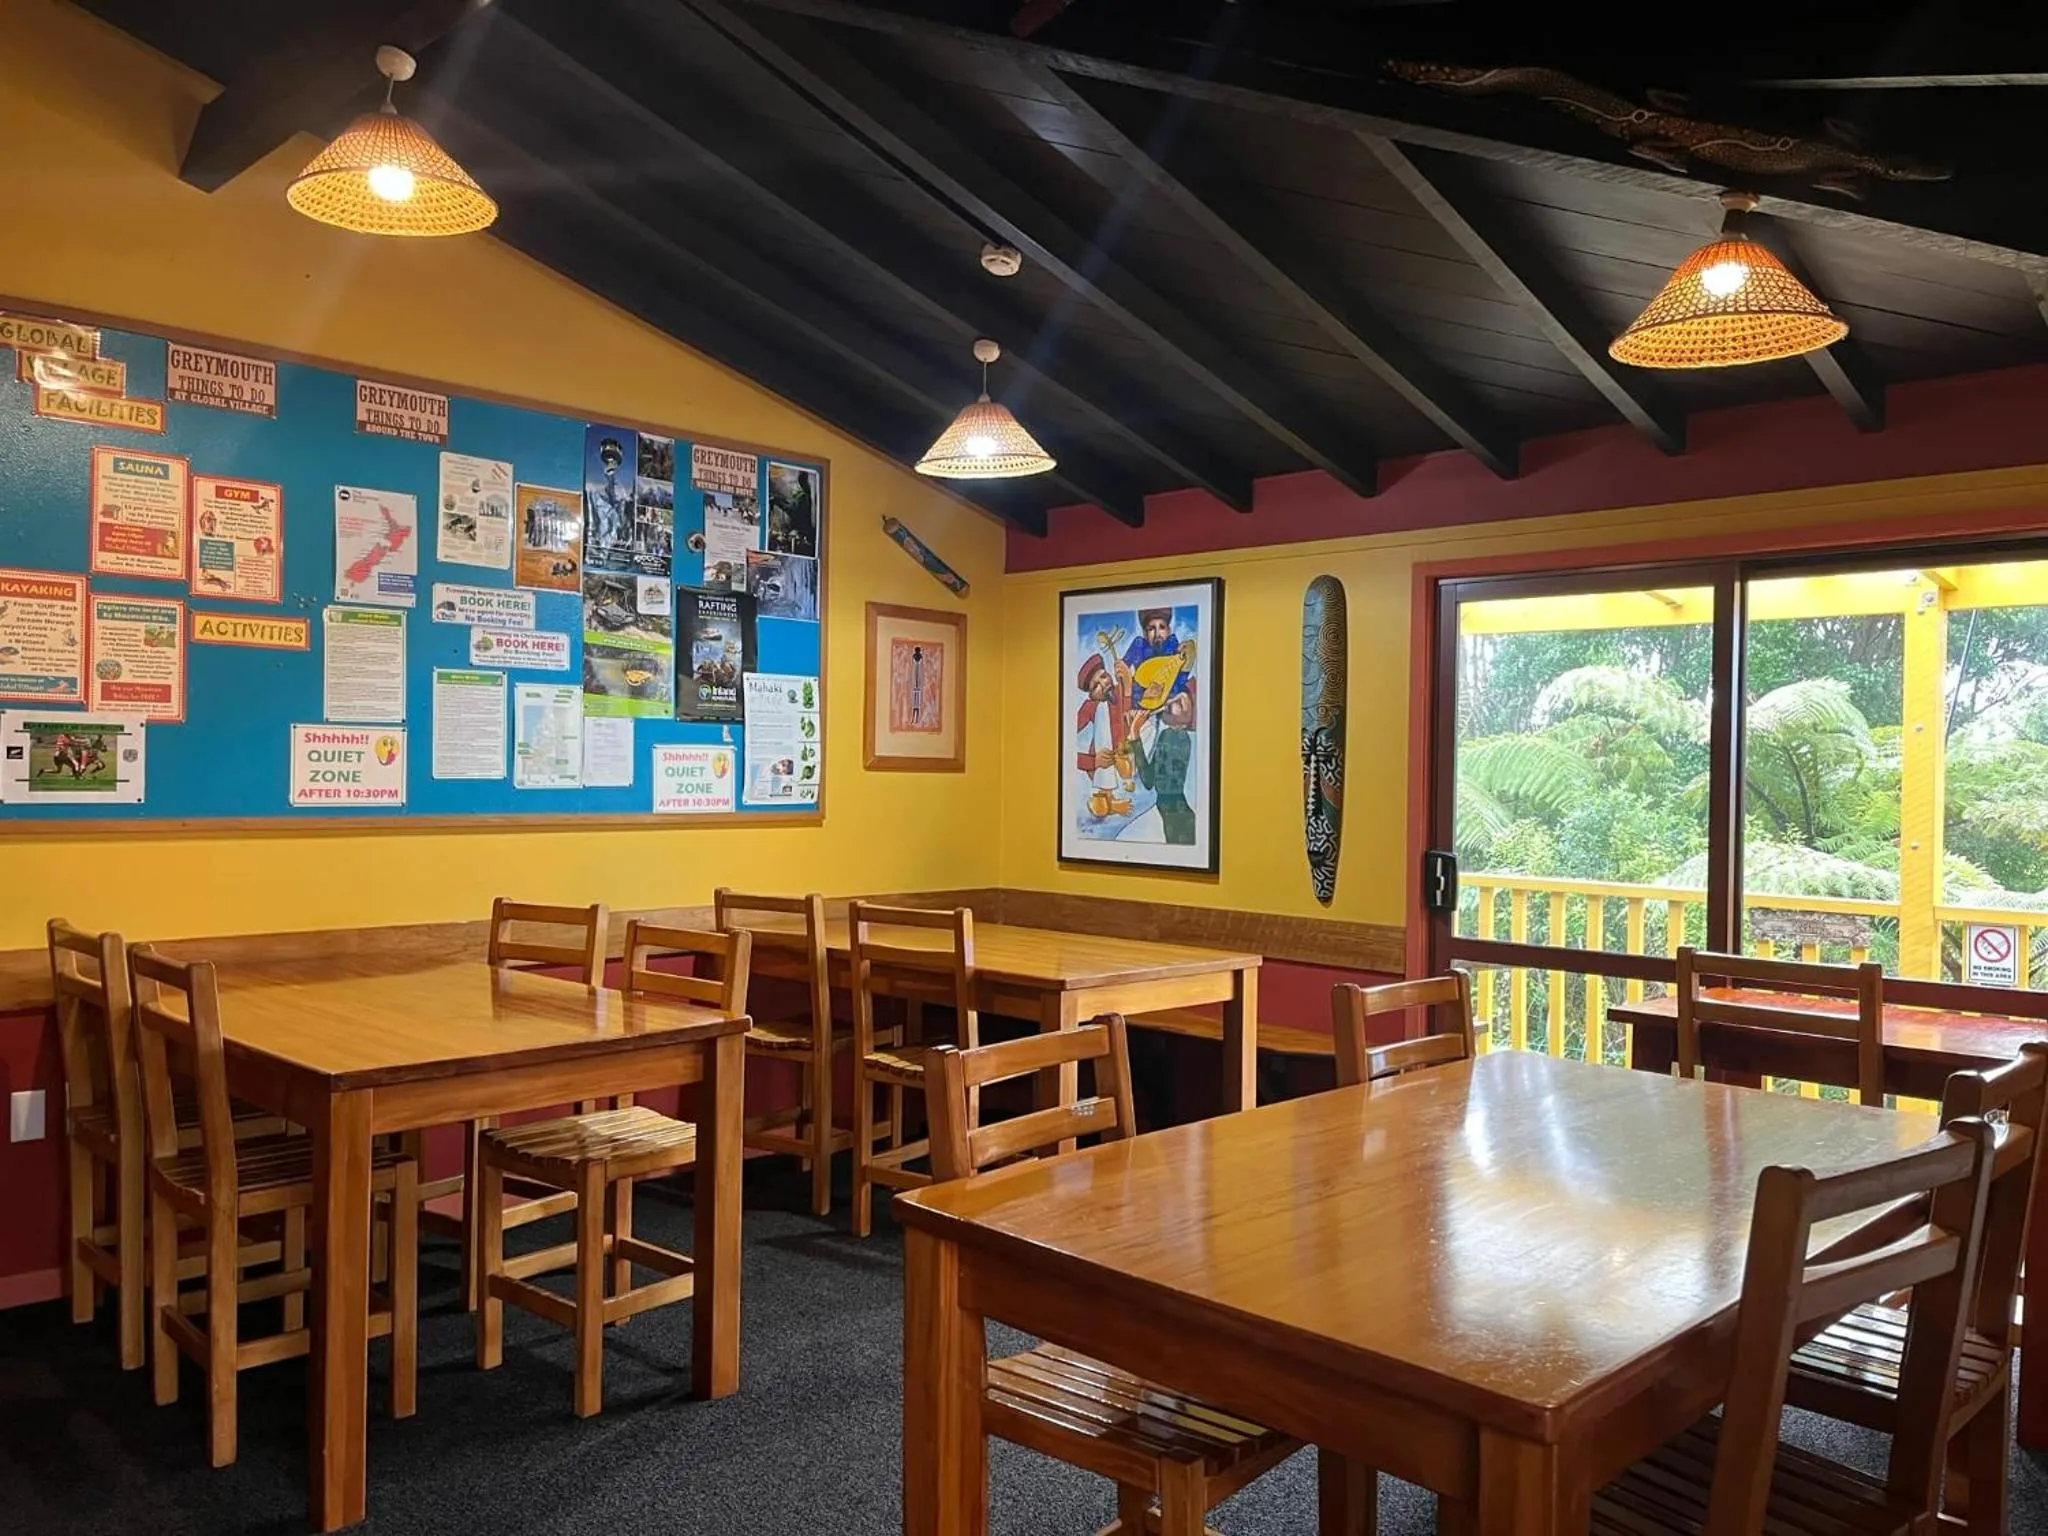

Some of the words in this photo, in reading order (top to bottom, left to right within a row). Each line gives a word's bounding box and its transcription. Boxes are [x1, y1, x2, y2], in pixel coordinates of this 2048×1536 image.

[0, 321, 89, 353] GLOBAL
[171, 350, 273, 385] GREYMOUTH
[178, 375, 224, 395] THINGS
[229, 383, 244, 400] TO
[250, 387, 266, 405] DO
[359, 385, 446, 417] GREYMOUTH
[45, 392, 158, 426] FACILITIES
[365, 408, 405, 427] THINGS
[409, 416, 422, 430] TO
[427, 419, 440, 434] DO
[119, 461, 164, 476] SAUNA
[693, 448, 756, 474] GREYMOUTH
[699, 468, 730, 483] THINGS
[224, 488, 250, 499] GYM
[1, 582, 73, 598] KAYAKING
[459, 596, 494, 608] BOOK
[497, 599, 531, 611] HERE!
[698, 600, 737, 613] RAFTING
[477, 616, 507, 626] Booking
[200, 619, 304, 643] ACTIVITIES
[496, 638, 529, 649] BOOK
[532, 641, 565, 652] HERE!
[304, 733, 370, 745] Shhhhh!!
[307, 750, 365, 763] QUIET
[309, 770, 362, 783] ZONE
[664, 766, 706, 778] QUIET
[298, 788, 342, 799] AFTER
[346, 789, 398, 799] 10:30PM
[675, 783, 714, 794] ZONE
[658, 798, 690, 807] AFTER
